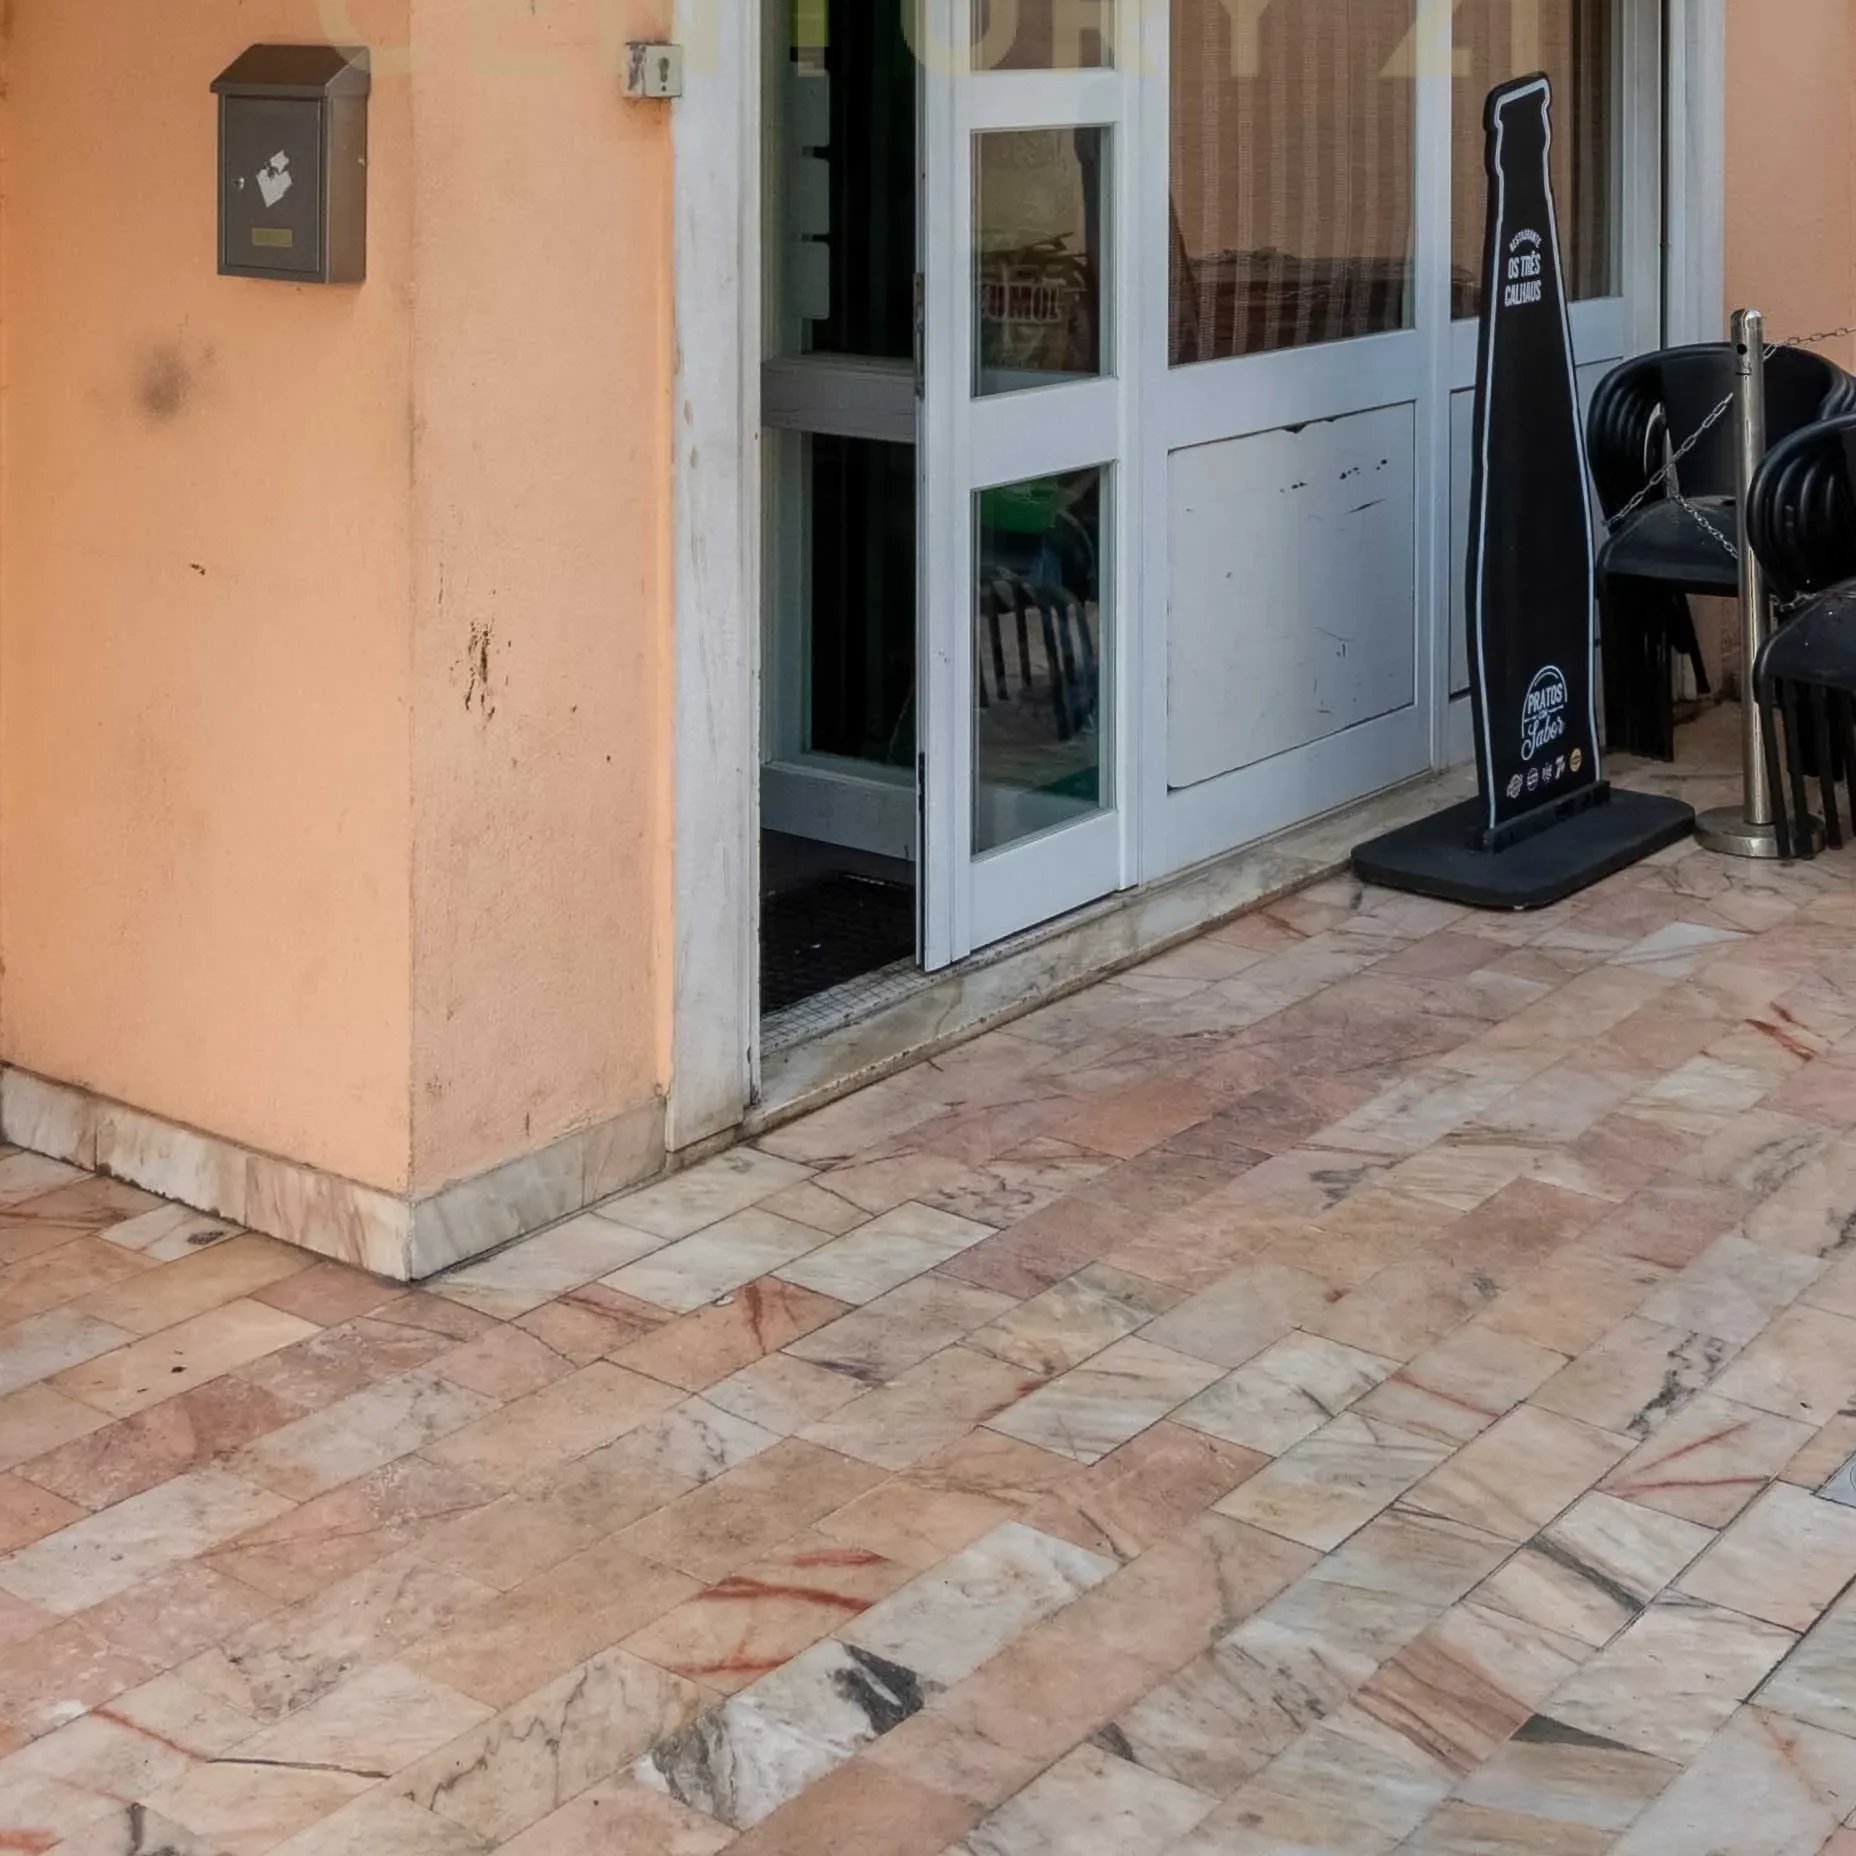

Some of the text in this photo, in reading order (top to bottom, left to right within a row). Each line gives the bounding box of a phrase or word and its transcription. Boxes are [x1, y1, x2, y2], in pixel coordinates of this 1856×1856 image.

[1508, 257, 1520, 280] OS
[1505, 280, 1542, 307] CALHAUS
[1528, 682, 1563, 715] PRATOS
[1521, 714, 1565, 761] Sabor
